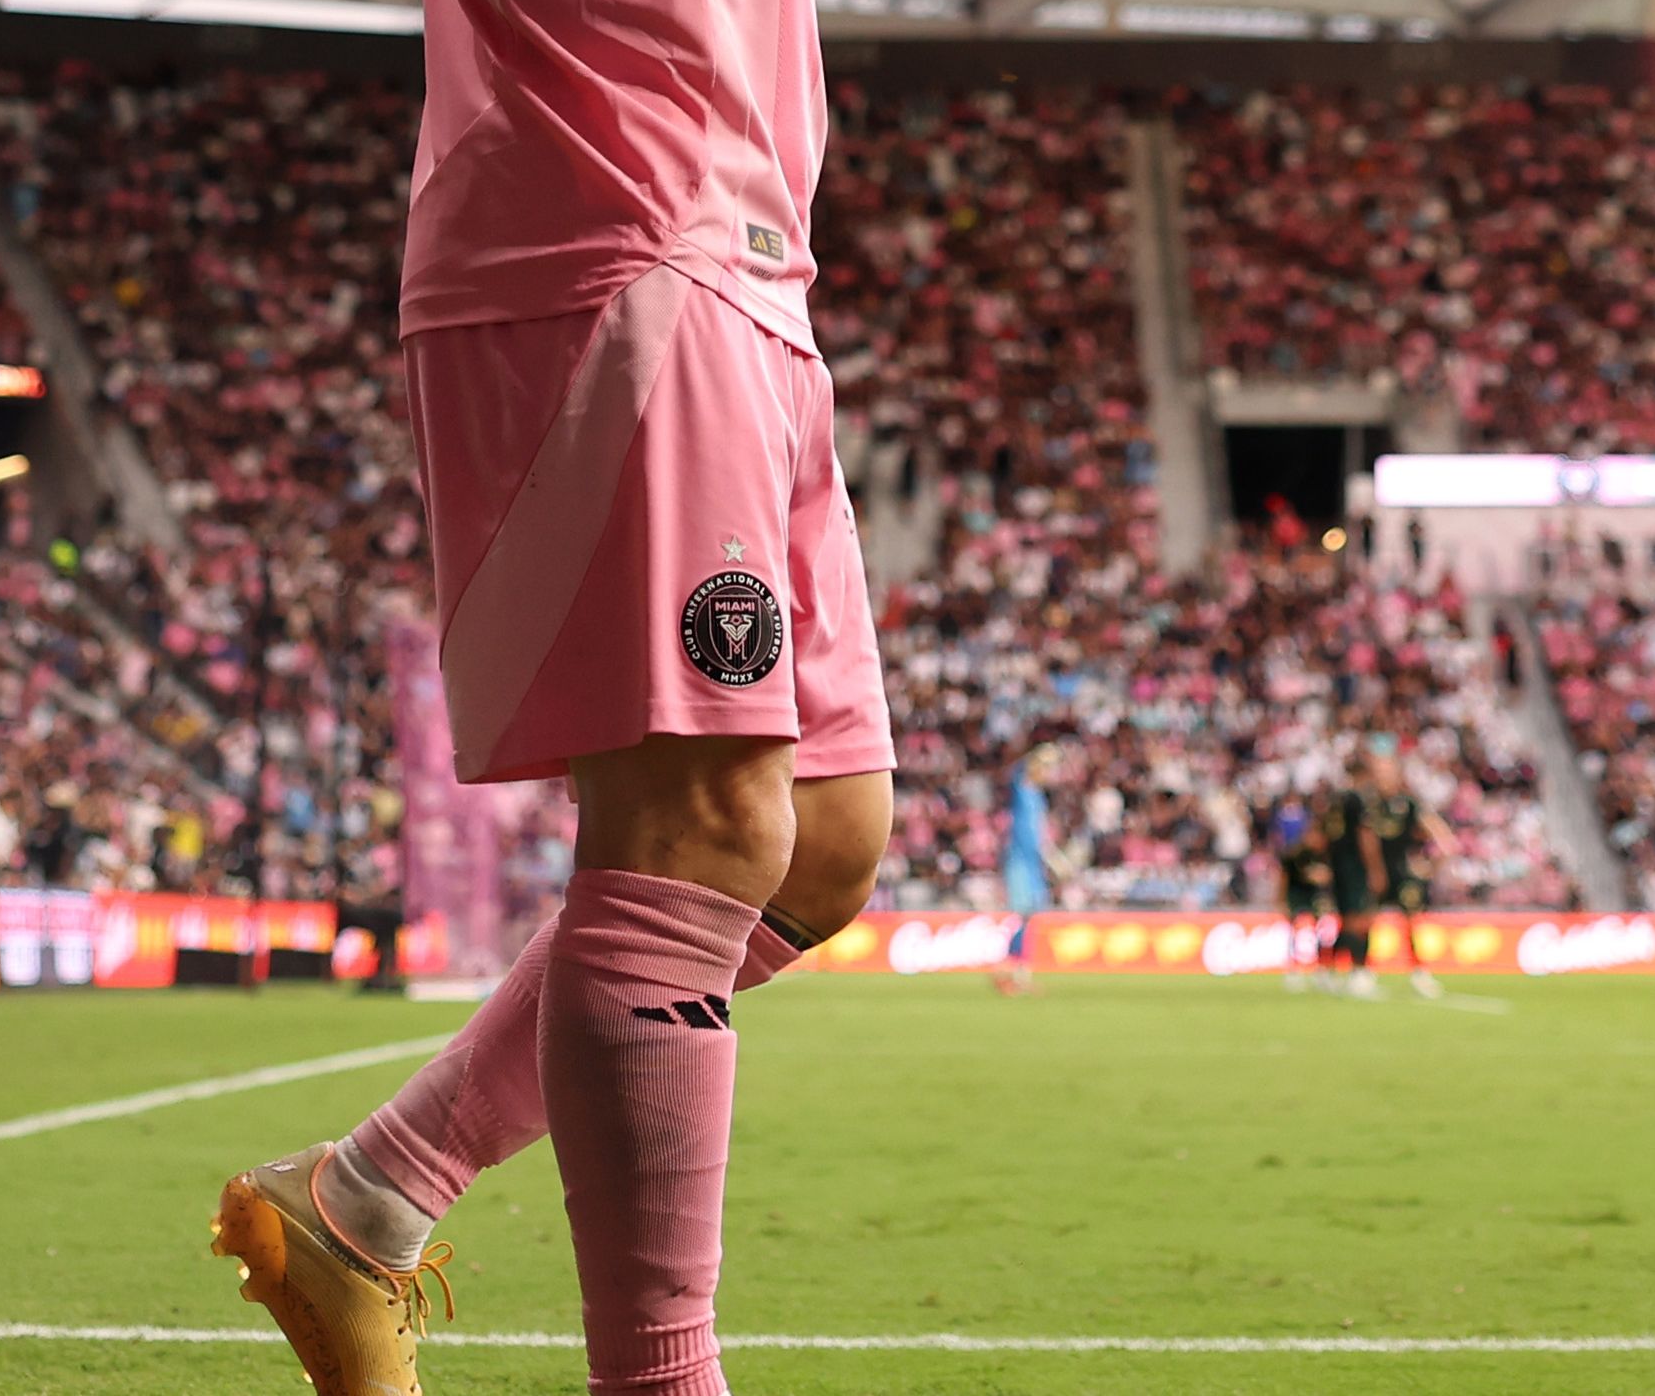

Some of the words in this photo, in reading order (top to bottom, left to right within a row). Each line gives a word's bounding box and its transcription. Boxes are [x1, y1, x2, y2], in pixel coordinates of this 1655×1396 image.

[685, 574, 766, 623] INTERNACIONAL
[714, 601, 756, 612] MIAMI
[684, 628, 701, 660] CLUB
[720, 671, 755, 683] MMXX
